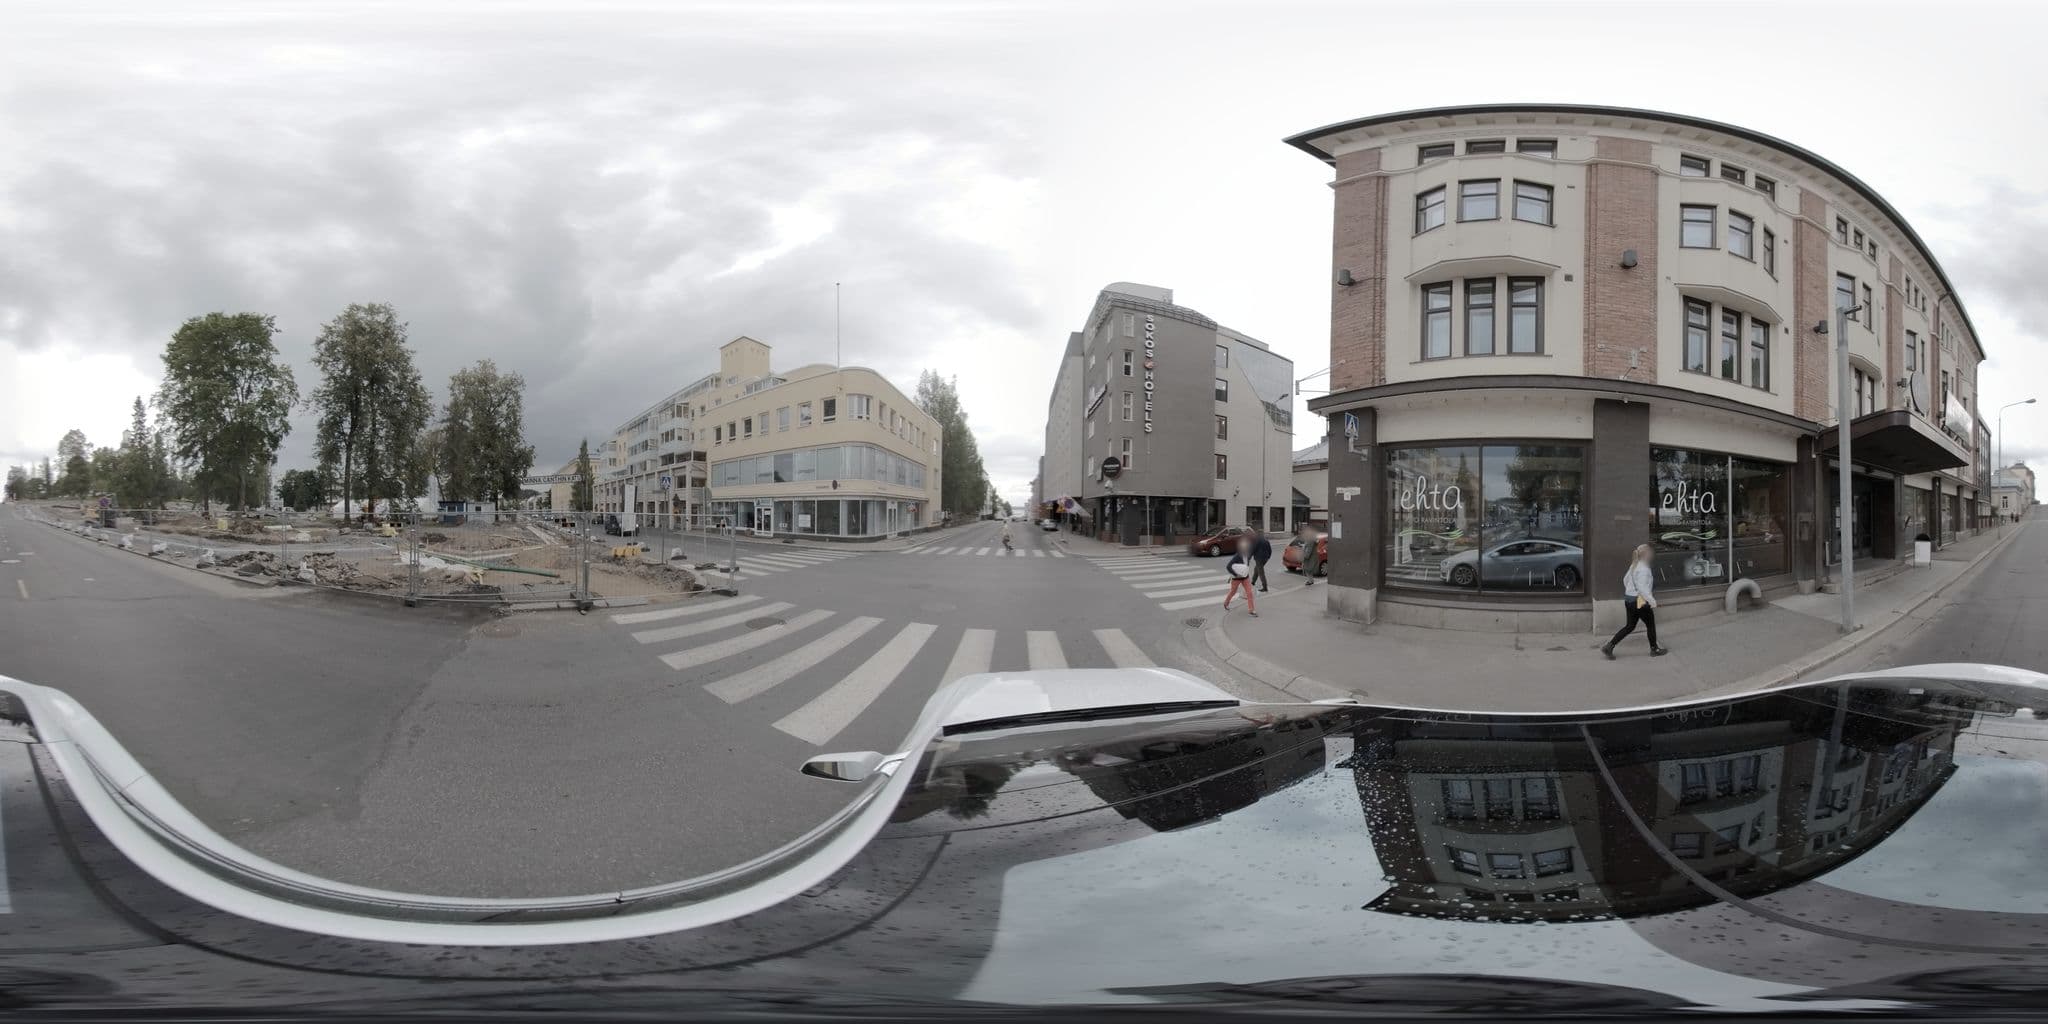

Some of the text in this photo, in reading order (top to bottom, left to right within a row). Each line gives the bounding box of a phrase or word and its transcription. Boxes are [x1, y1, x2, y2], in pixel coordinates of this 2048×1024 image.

[1144, 314, 1155, 433] SOKOS HOTELS
[1401, 475, 1463, 510] ehta
[1662, 480, 1717, 514] ehta
